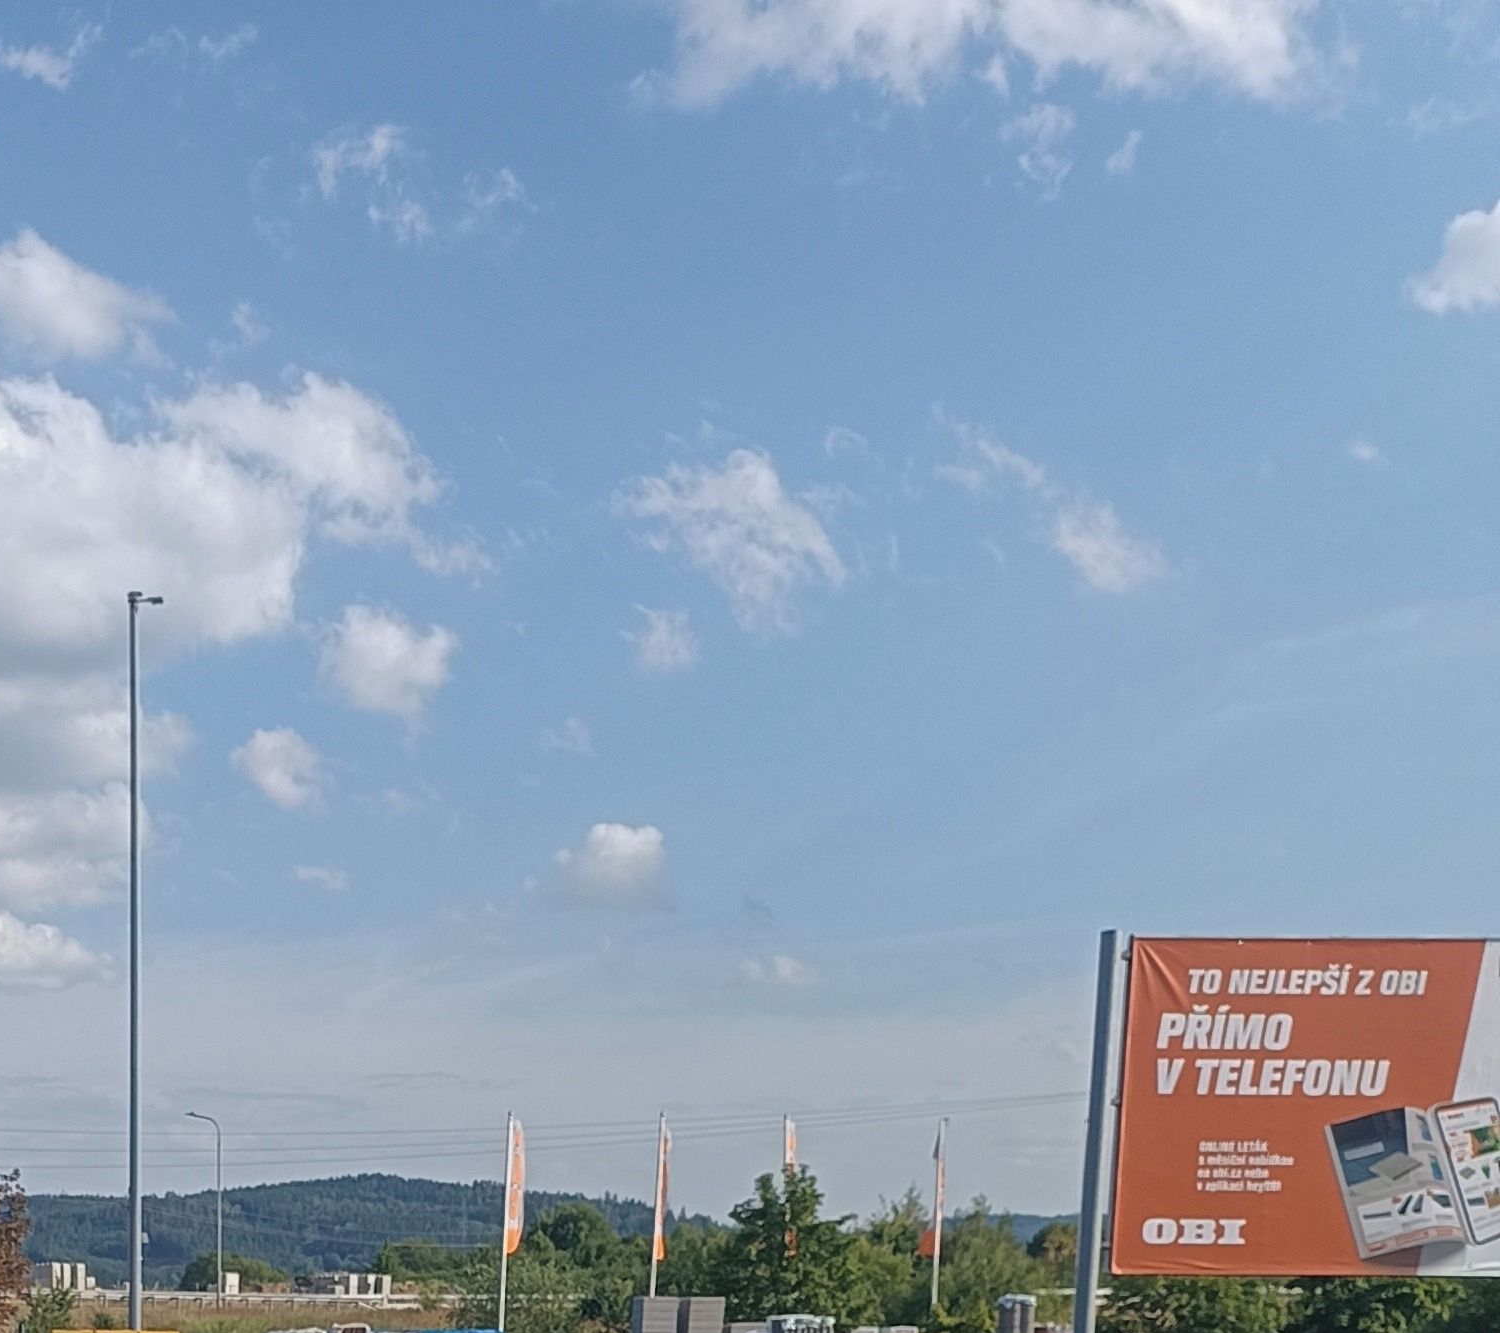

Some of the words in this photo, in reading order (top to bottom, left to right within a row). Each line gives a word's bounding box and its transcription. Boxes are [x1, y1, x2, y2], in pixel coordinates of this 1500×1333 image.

[1188, 968, 1222, 994] TO
[1228, 963, 1353, 995] NEJLEPŠÍ
[1355, 970, 1373, 995] Z
[1379, 969, 1428, 996] OBI
[1156, 1004, 1294, 1051] PŘÍMO
[1156, 1058, 1185, 1095] V
[1195, 1058, 1391, 1097] TELEFONU
[1141, 1218, 1247, 1245] OBI
